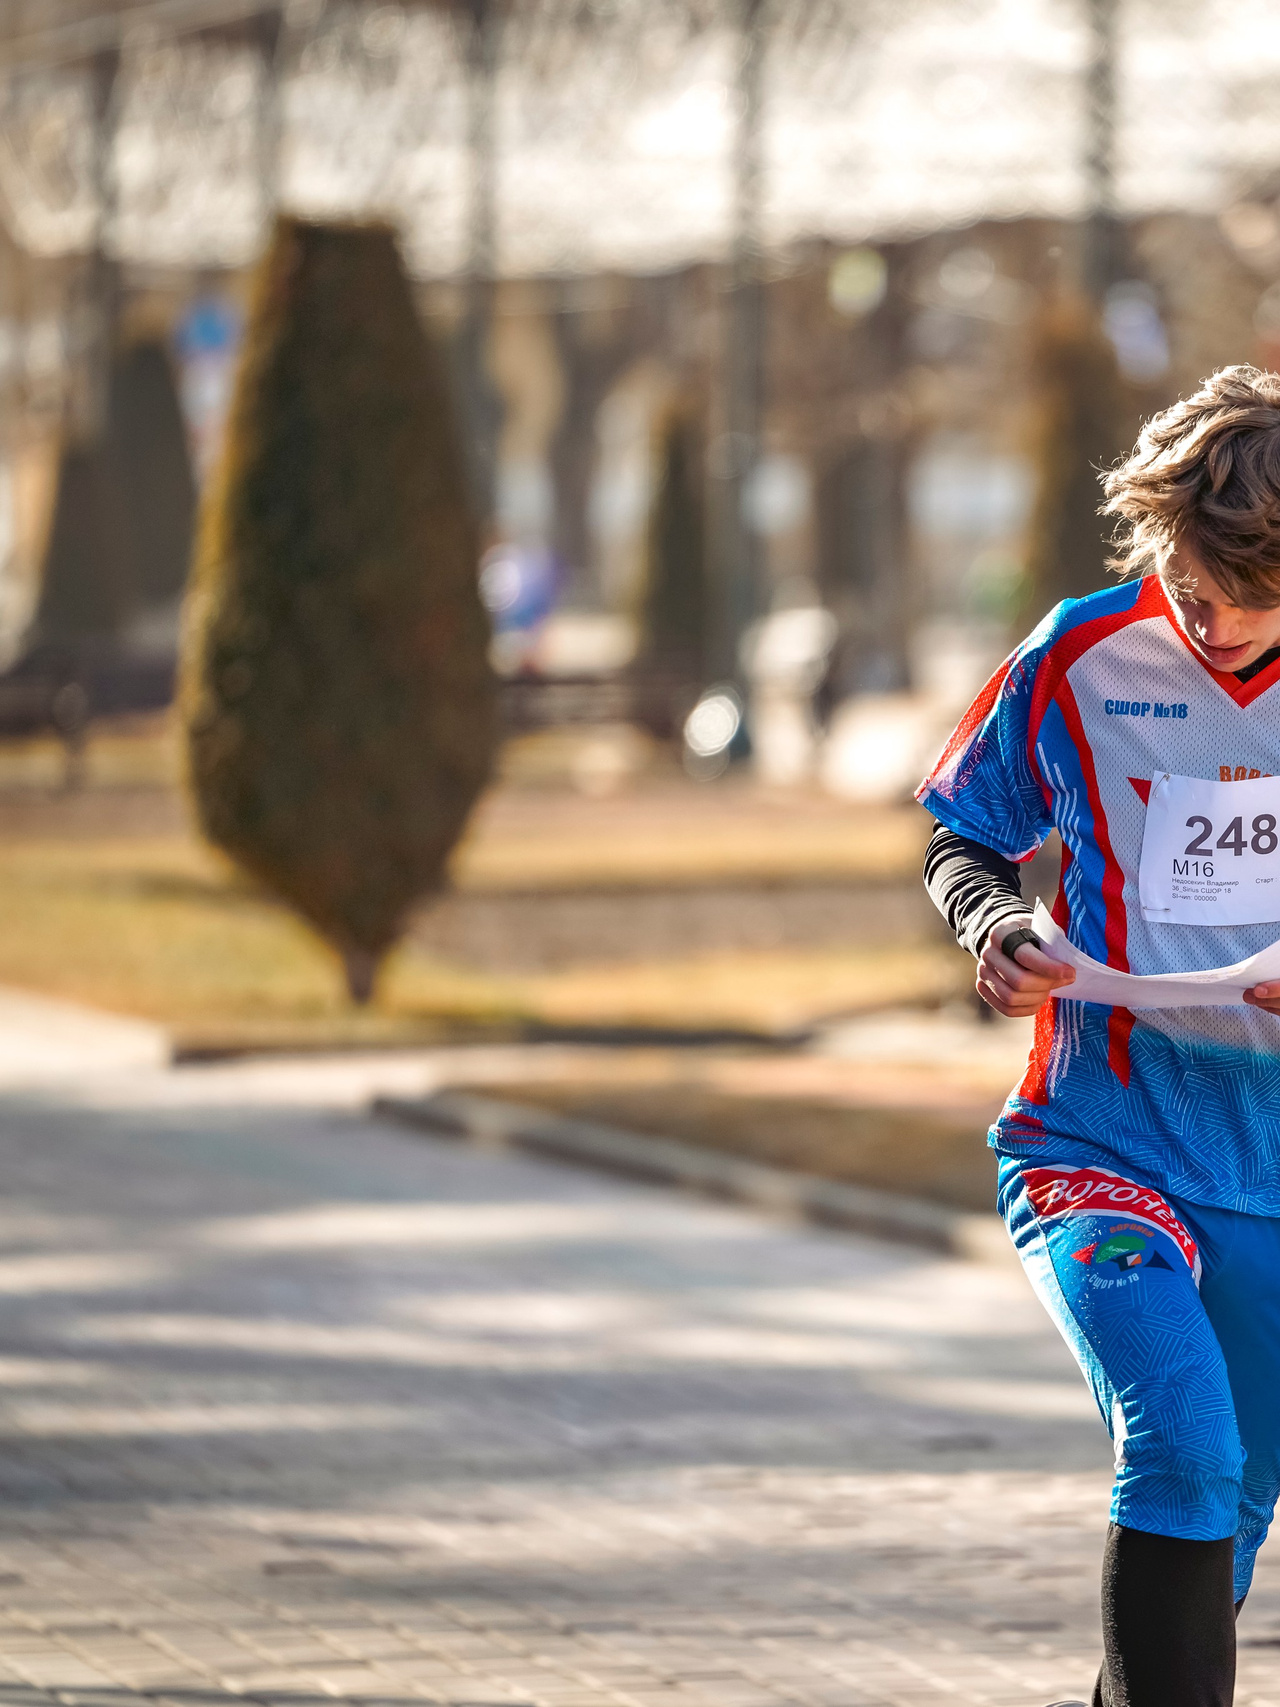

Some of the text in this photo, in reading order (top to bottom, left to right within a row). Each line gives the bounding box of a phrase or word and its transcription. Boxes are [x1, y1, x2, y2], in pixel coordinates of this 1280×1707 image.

[1105, 699, 1188, 718] СШОР №18
[1219, 765, 1274, 782] ВОР
[1184, 814, 1278, 856] 248
[1207, 879, 1240, 887] Владимир
[1193, 894, 1217, 902] 000000
[1046, 1179, 1193, 1249] ВОРОНЕЖ
[1088, 1274, 1115, 1290] СШОР
[1127, 1273, 1140, 1283] 18
